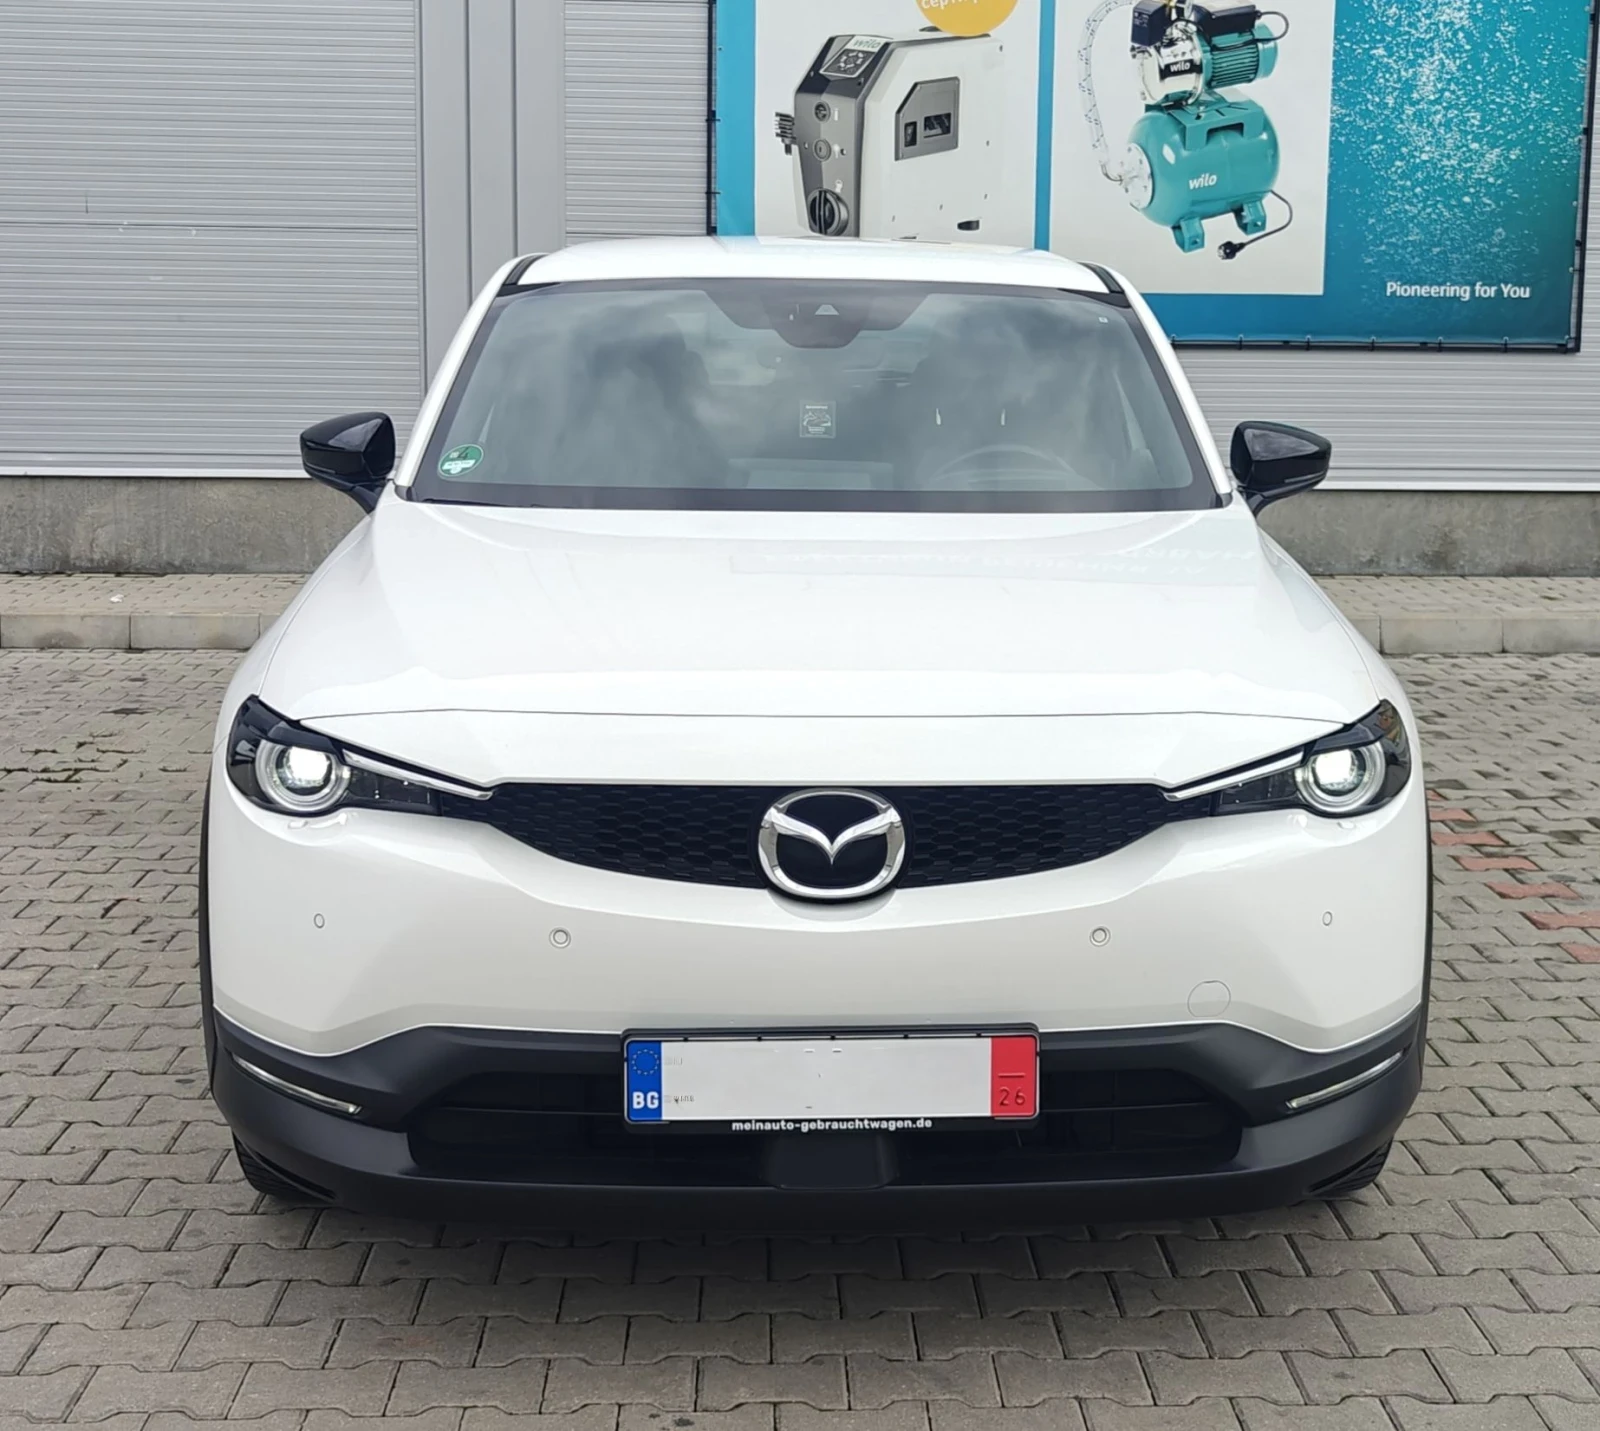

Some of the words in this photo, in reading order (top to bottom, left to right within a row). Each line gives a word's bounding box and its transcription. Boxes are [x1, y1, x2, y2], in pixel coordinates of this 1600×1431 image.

[853, 38, 881, 49] wilo
[1170, 60, 1191, 72] wilo
[1188, 173, 1217, 190] wilo
[1386, 281, 1471, 301] Pioneering
[1474, 282, 1498, 298] for
[1500, 283, 1530, 298] You
[632, 1091, 660, 1110] BG
[996, 1085, 1026, 1107] 26
[731, 1117, 933, 1133] meinauto-gebrauchtwagen.de
